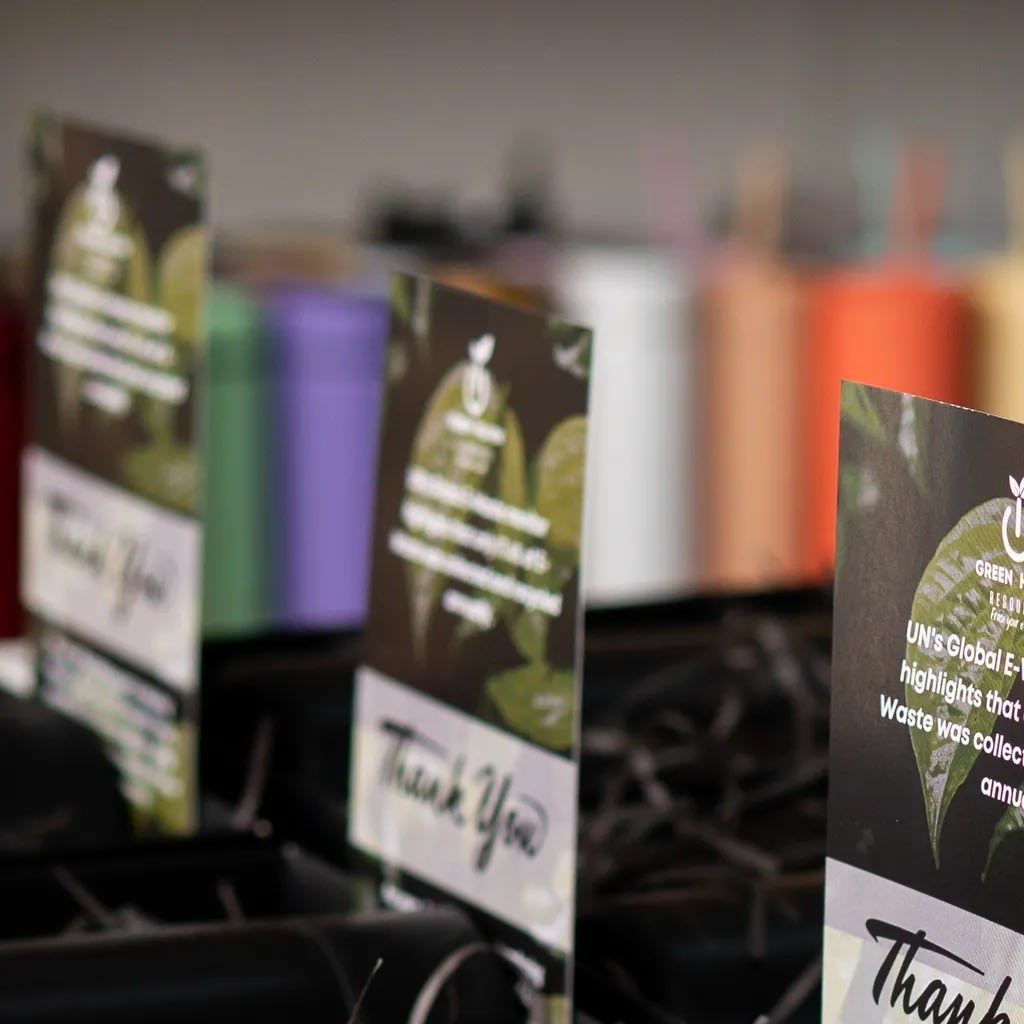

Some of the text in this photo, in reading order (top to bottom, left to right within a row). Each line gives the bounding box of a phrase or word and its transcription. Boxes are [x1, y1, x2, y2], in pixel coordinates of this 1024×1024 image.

[975, 559, 1014, 587] GREEN
[906, 619, 943, 653] UN's
[946, 633, 1002, 673] Global
[899, 658, 983, 708] highlights
[985, 689, 1021, 723] that
[880, 693, 934, 733] Waste
[937, 717, 970, 746] was
